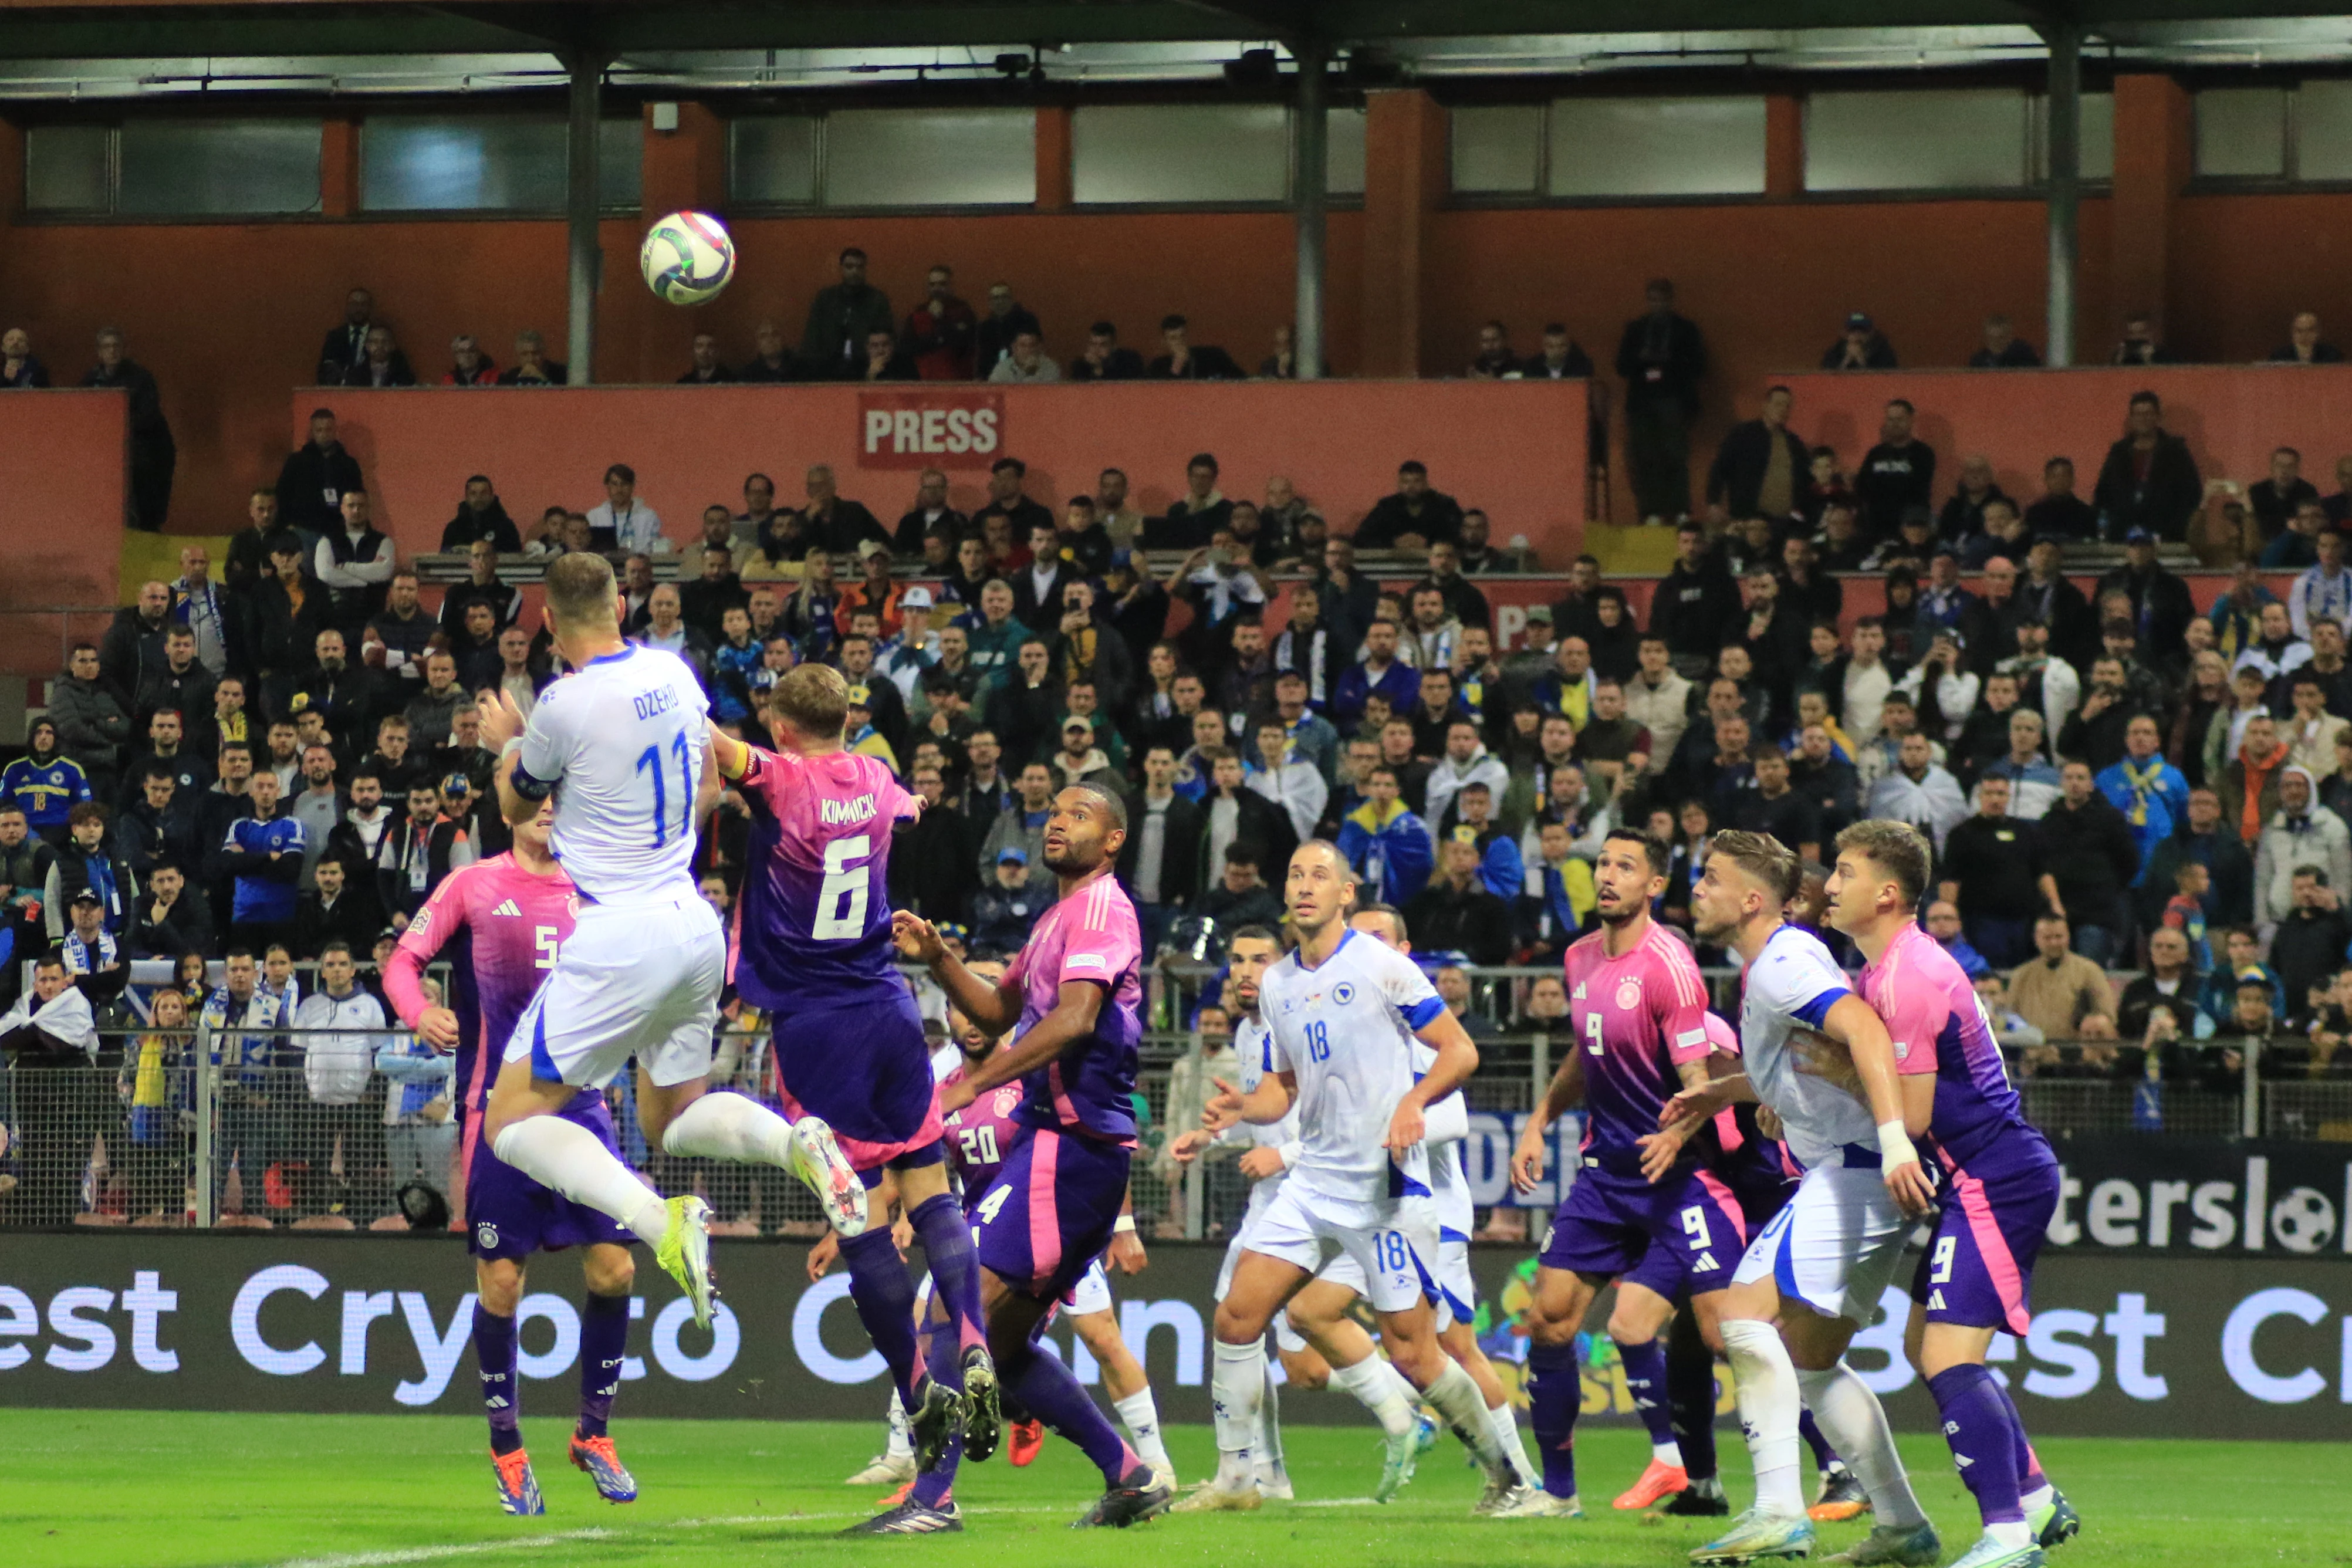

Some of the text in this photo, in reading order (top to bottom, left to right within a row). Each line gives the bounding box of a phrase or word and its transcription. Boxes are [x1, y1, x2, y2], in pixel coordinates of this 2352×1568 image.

[866, 409, 997, 454] PRESS
[636, 728, 692, 850] 11
[812, 834, 871, 940] 6
[535, 925, 557, 968] 5
[1303, 1020, 1331, 1063] 18
[1586, 1012, 1604, 1056] 9
[958, 1125, 1001, 1165] 20
[976, 1184, 1013, 1225] 4
[1681, 1205, 1712, 1251] 9
[1372, 1231, 1405, 1273] 18
